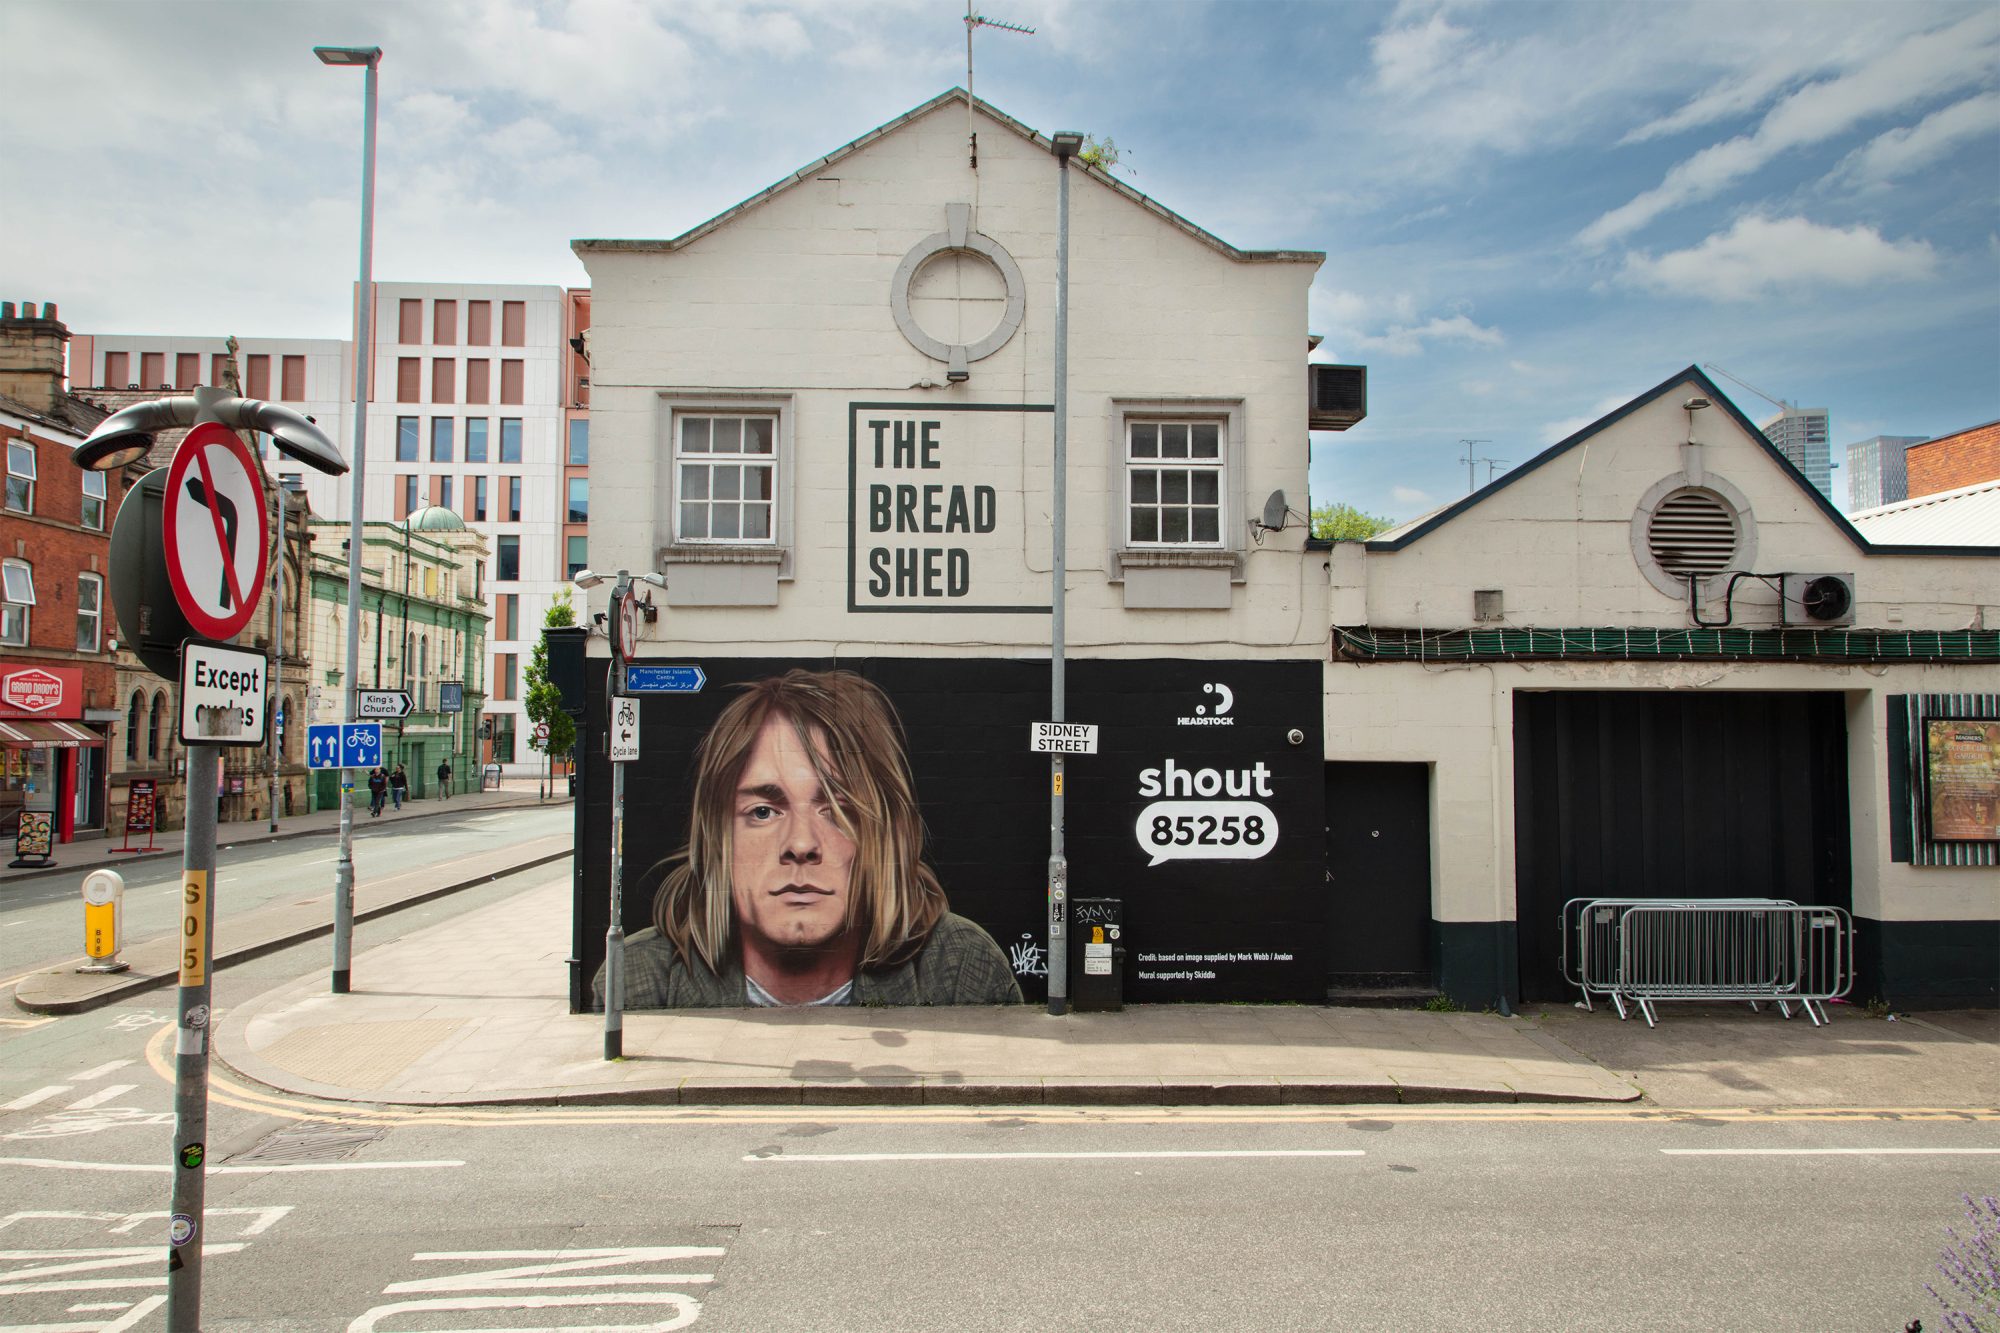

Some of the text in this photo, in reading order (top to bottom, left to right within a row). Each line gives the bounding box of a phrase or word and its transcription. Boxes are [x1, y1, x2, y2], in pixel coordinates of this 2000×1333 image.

[868, 420, 941, 469] THE
[870, 484, 996, 533] BREAD
[869, 547, 970, 598] SHED
[194, 660, 259, 696] Except
[367, 695, 394, 704] King's
[363, 704, 397, 713] Church
[1177, 717, 1234, 726] HEADSTOCK
[1039, 724, 1090, 738] SIDNEY
[613, 746, 638, 757] Cycle lane
[1038, 738, 1091, 752] STREET
[1138, 758, 1274, 798] shout
[1151, 815, 1265, 846] 85258
[1158, 953, 1175, 962] based
[1185, 953, 1203, 963] image
[1204, 953, 1228, 963] supplied
[1229, 953, 1237, 962] by
[1237, 952, 1252, 961] Mark
[1253, 952, 1269, 961] Webb
[1274, 952, 1293, 961] Avalon
[1138, 970, 1215, 981] Mural supported by Skiddle
